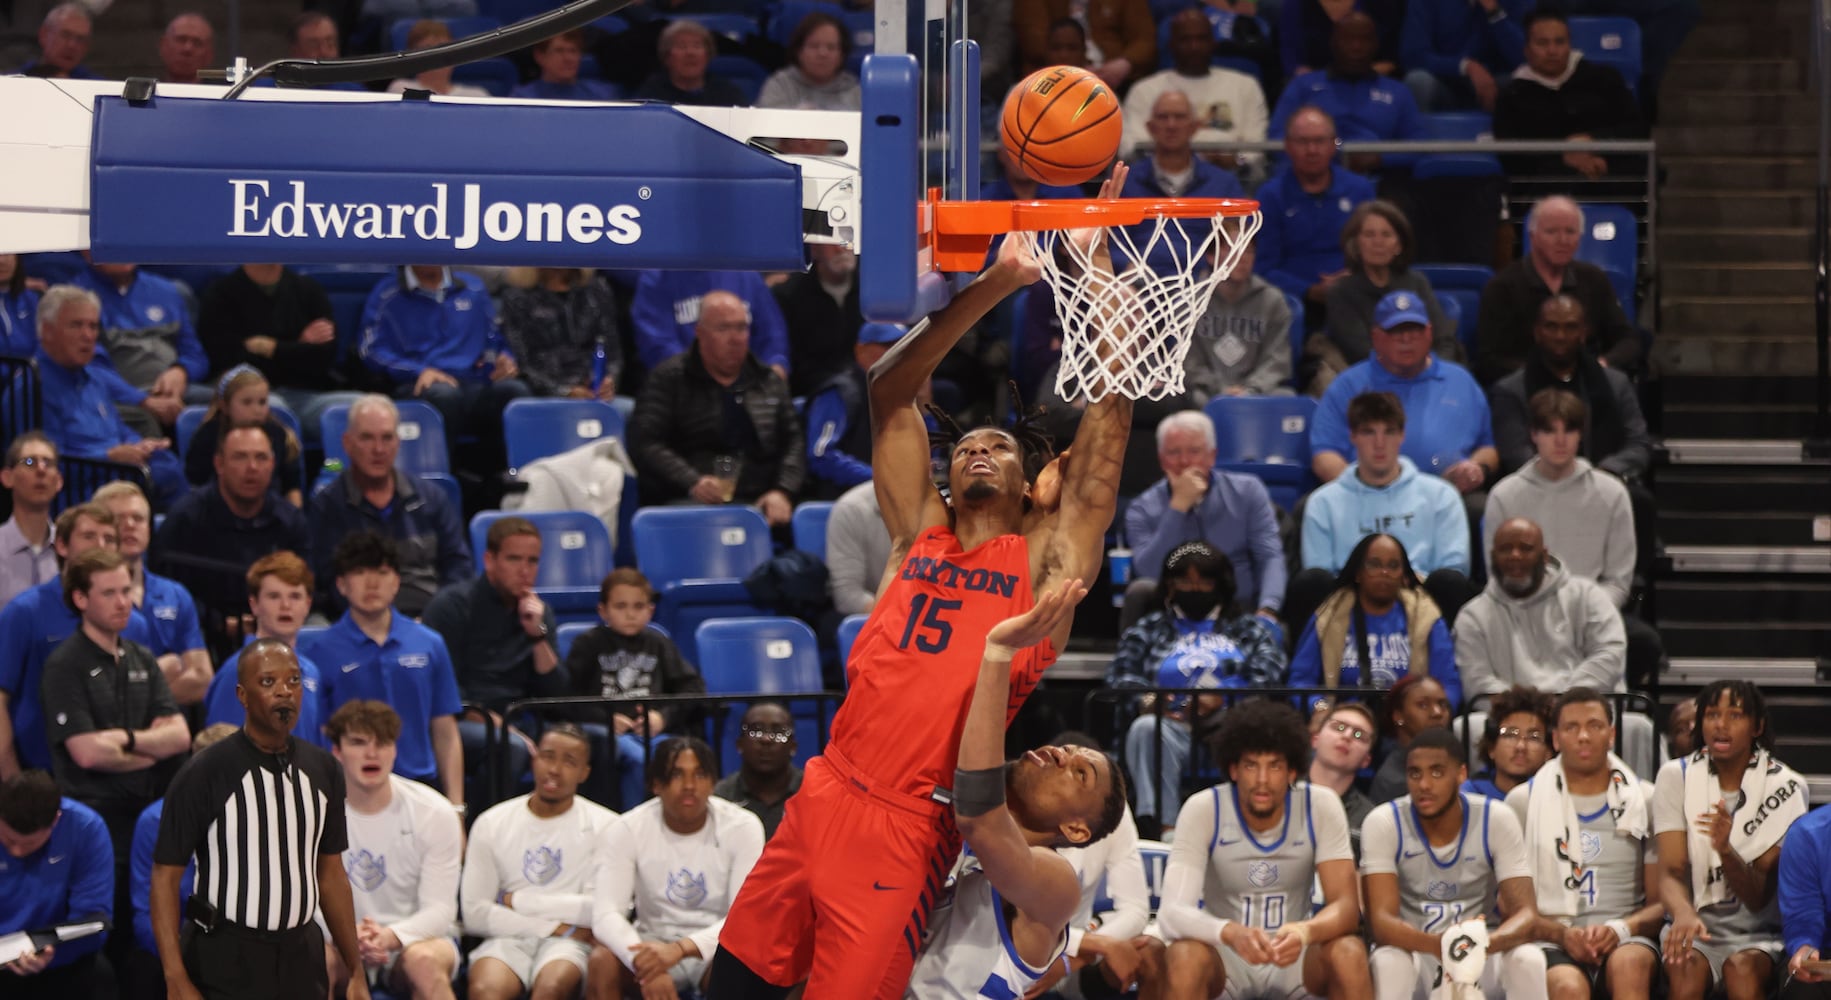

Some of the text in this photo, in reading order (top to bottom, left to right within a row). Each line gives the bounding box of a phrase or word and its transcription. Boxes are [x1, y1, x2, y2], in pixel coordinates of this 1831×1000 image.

[899, 593, 963, 654] 15
[1578, 869, 1597, 907] 4
[1241, 894, 1286, 932] 10
